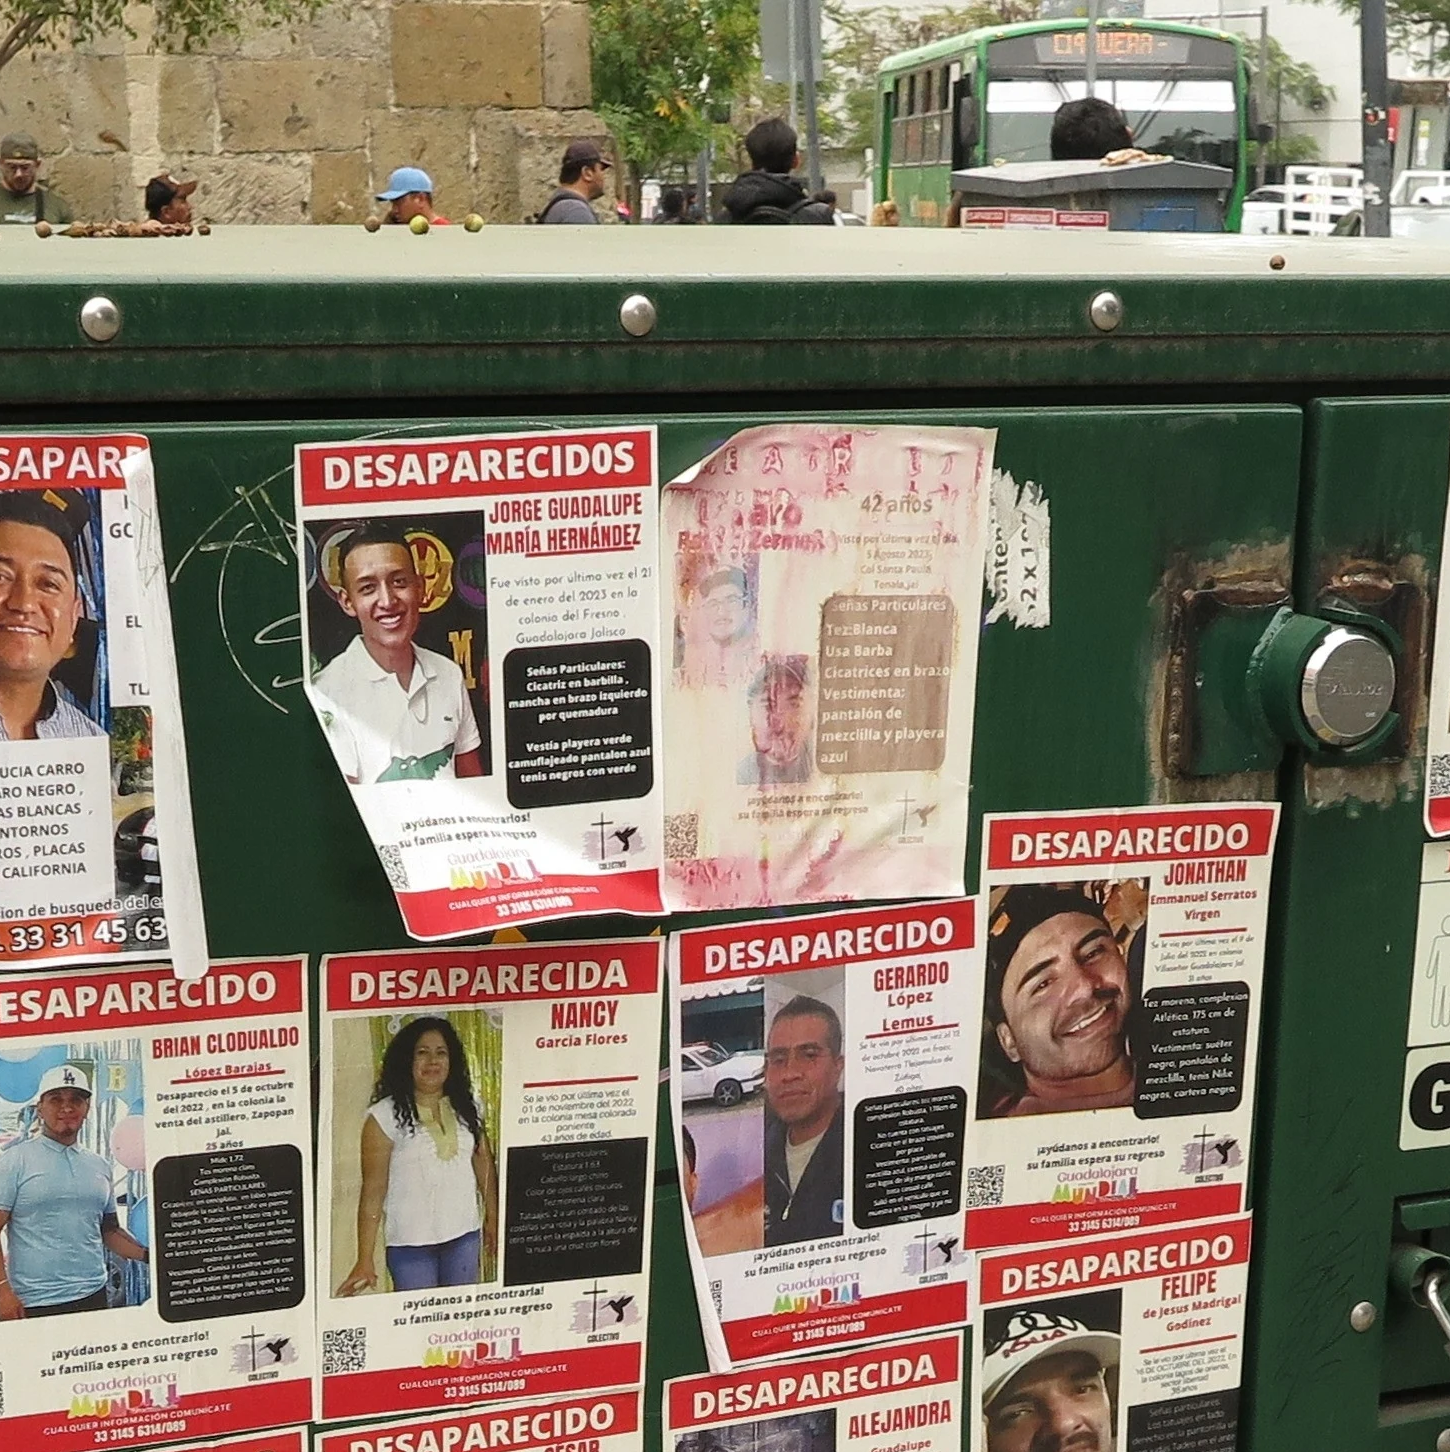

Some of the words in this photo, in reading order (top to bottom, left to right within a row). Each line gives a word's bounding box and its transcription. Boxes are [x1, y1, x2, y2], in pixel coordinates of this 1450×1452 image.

[322, 441, 635, 493] DESAPARECIDOS
[488, 502, 543, 525] JORGE
[549, 492, 642, 518] GUADALUPE
[860, 495, 882, 516] 42
[885, 492, 933, 519] años
[486, 524, 541, 556] MARÍA
[546, 523, 642, 551] HERNÁNDEZ
[825, 644, 851, 658] Usa
[855, 643, 893, 658] Barba
[824, 664, 890, 680] Cicatrices
[894, 666, 911, 679] en
[914, 664, 951, 678] brazo
[823, 687, 906, 700] Vestimenta:
[37, 763, 85, 776] CARRO
[820, 752, 848, 764] azul
[27, 784, 75, 797] NEGRO
[17, 803, 81, 818] BLANCAS
[34, 843, 85, 857] PLACAS
[1010, 822, 1249, 862] DESAPARECIDO
[2, 863, 86, 878] CALIFORNIA
[1163, 859, 1247, 887] JONATHAN
[9, 926, 45, 951] 33
[51, 923, 84, 948] 31
[93, 919, 127, 942] 45
[135, 917, 167, 941] 63
[704, 916, 955, 974] DESAPARECIDO
[350, 958, 628, 1002] DESAPARECIDA
[873, 961, 950, 992] GERARDO
[550, 1000, 619, 1030] NANCY
[151, 1034, 201, 1059] BRIAN
[205, 1027, 299, 1054] CLODUALDO
[1001, 1234, 1234, 1295] DESAPARECIDO
[1160, 1269, 1216, 1301] FELIPE
[692, 1354, 936, 1419] DESAPARECIDA
[848, 1399, 951, 1439] ALEJANDRA
